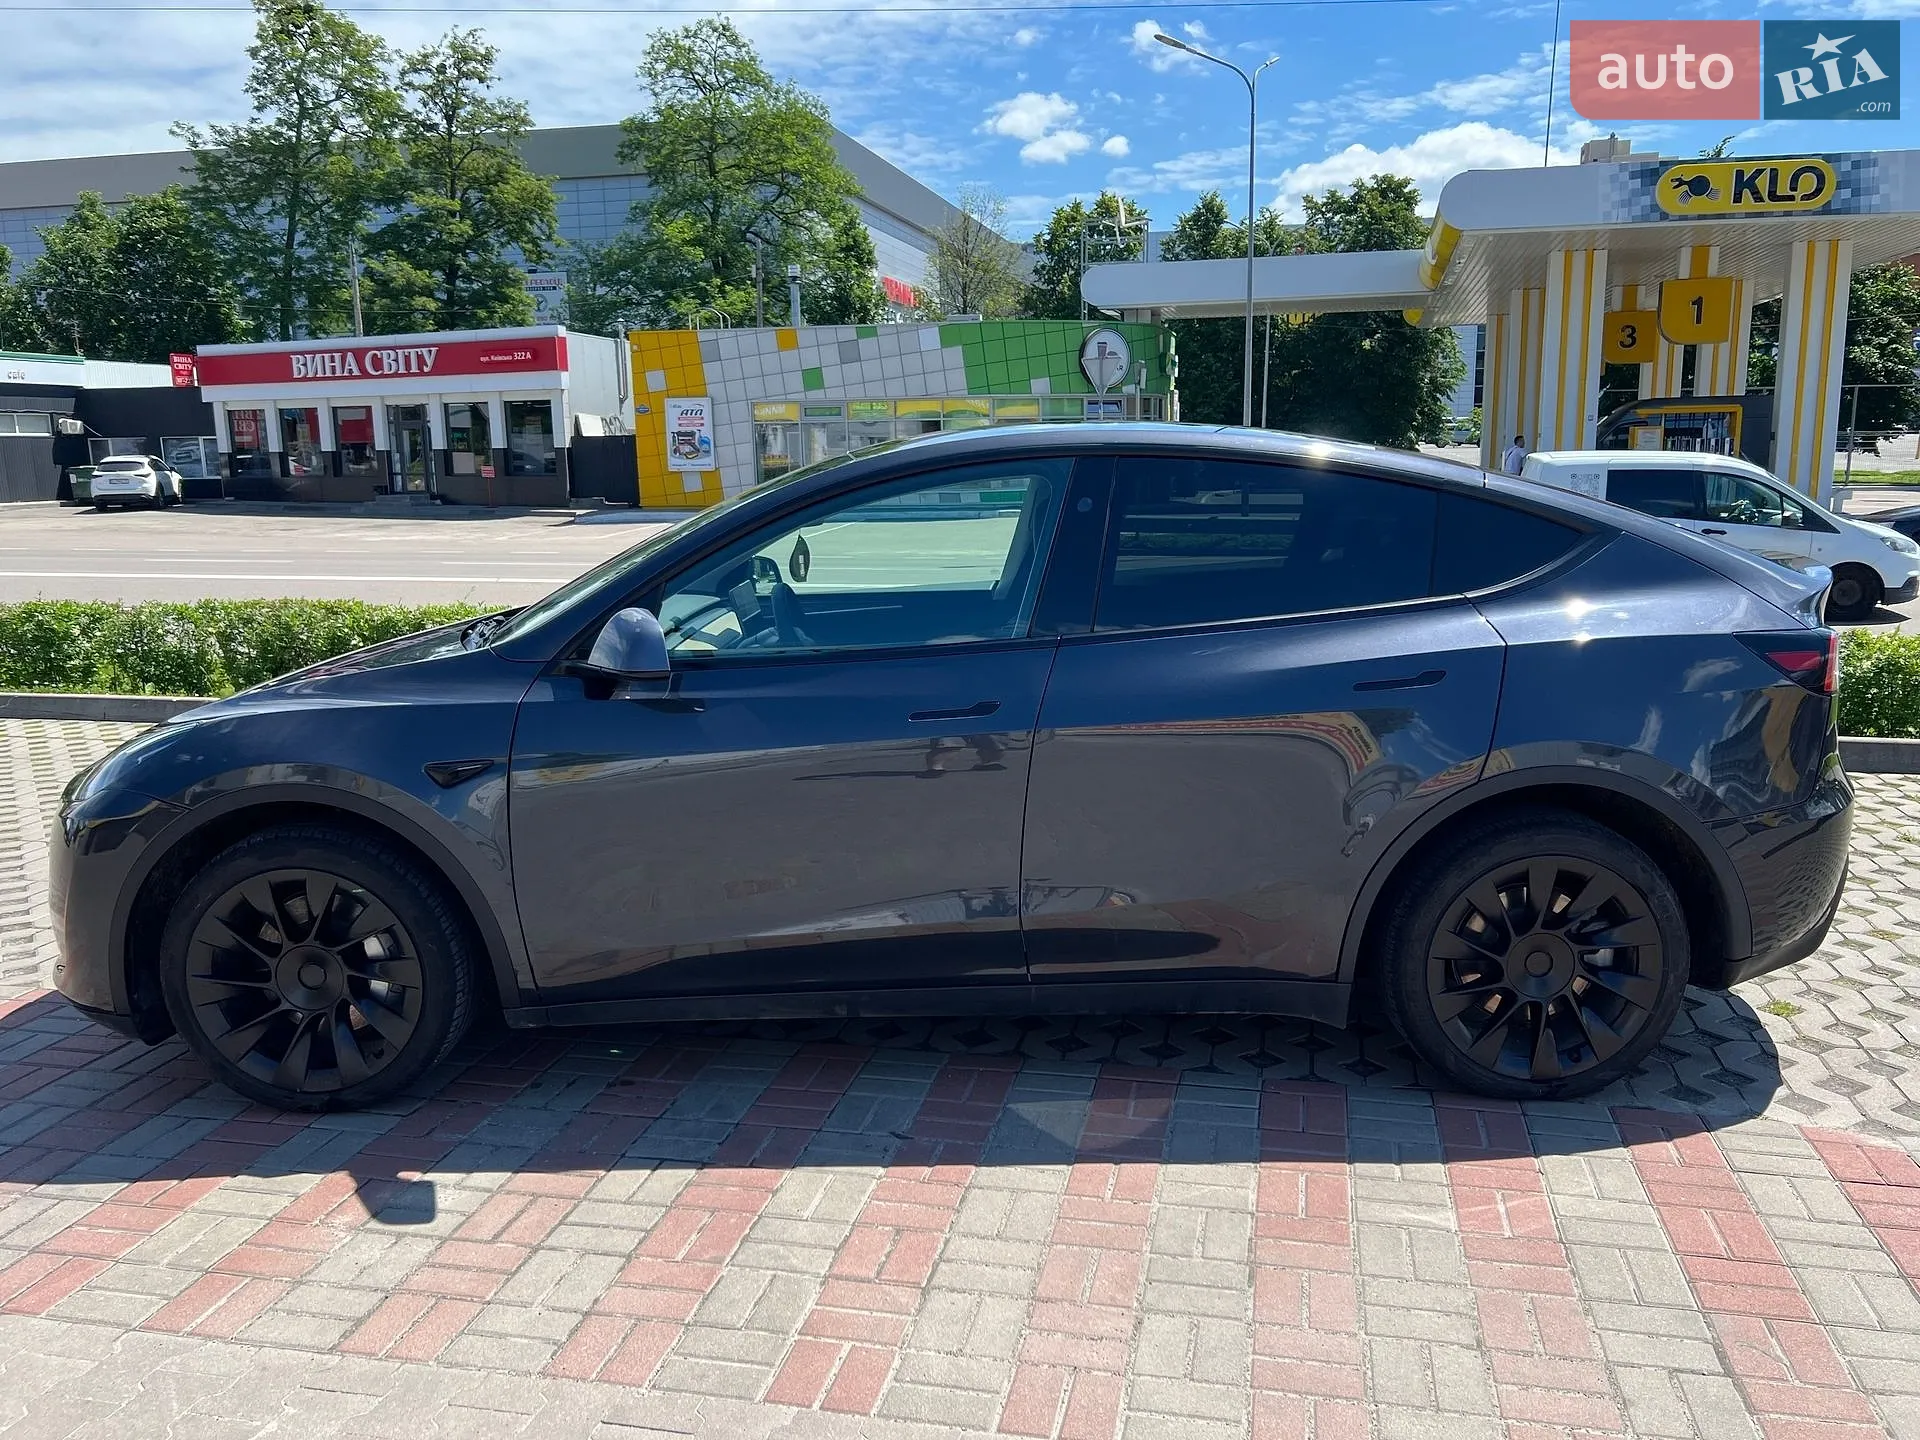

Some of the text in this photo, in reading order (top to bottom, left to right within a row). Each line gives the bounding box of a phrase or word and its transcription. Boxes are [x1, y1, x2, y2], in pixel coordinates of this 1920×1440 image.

[1732, 165, 1827, 206] KLO
[1691, 296, 1704, 325] 1
[1619, 324, 1637, 348] 3
[173, 356, 193, 364] ВИНА
[174, 363, 193, 371] СВІТУ
[290, 347, 438, 379] ВИНА СВІТУ
[513, 351, 526, 360] 322
